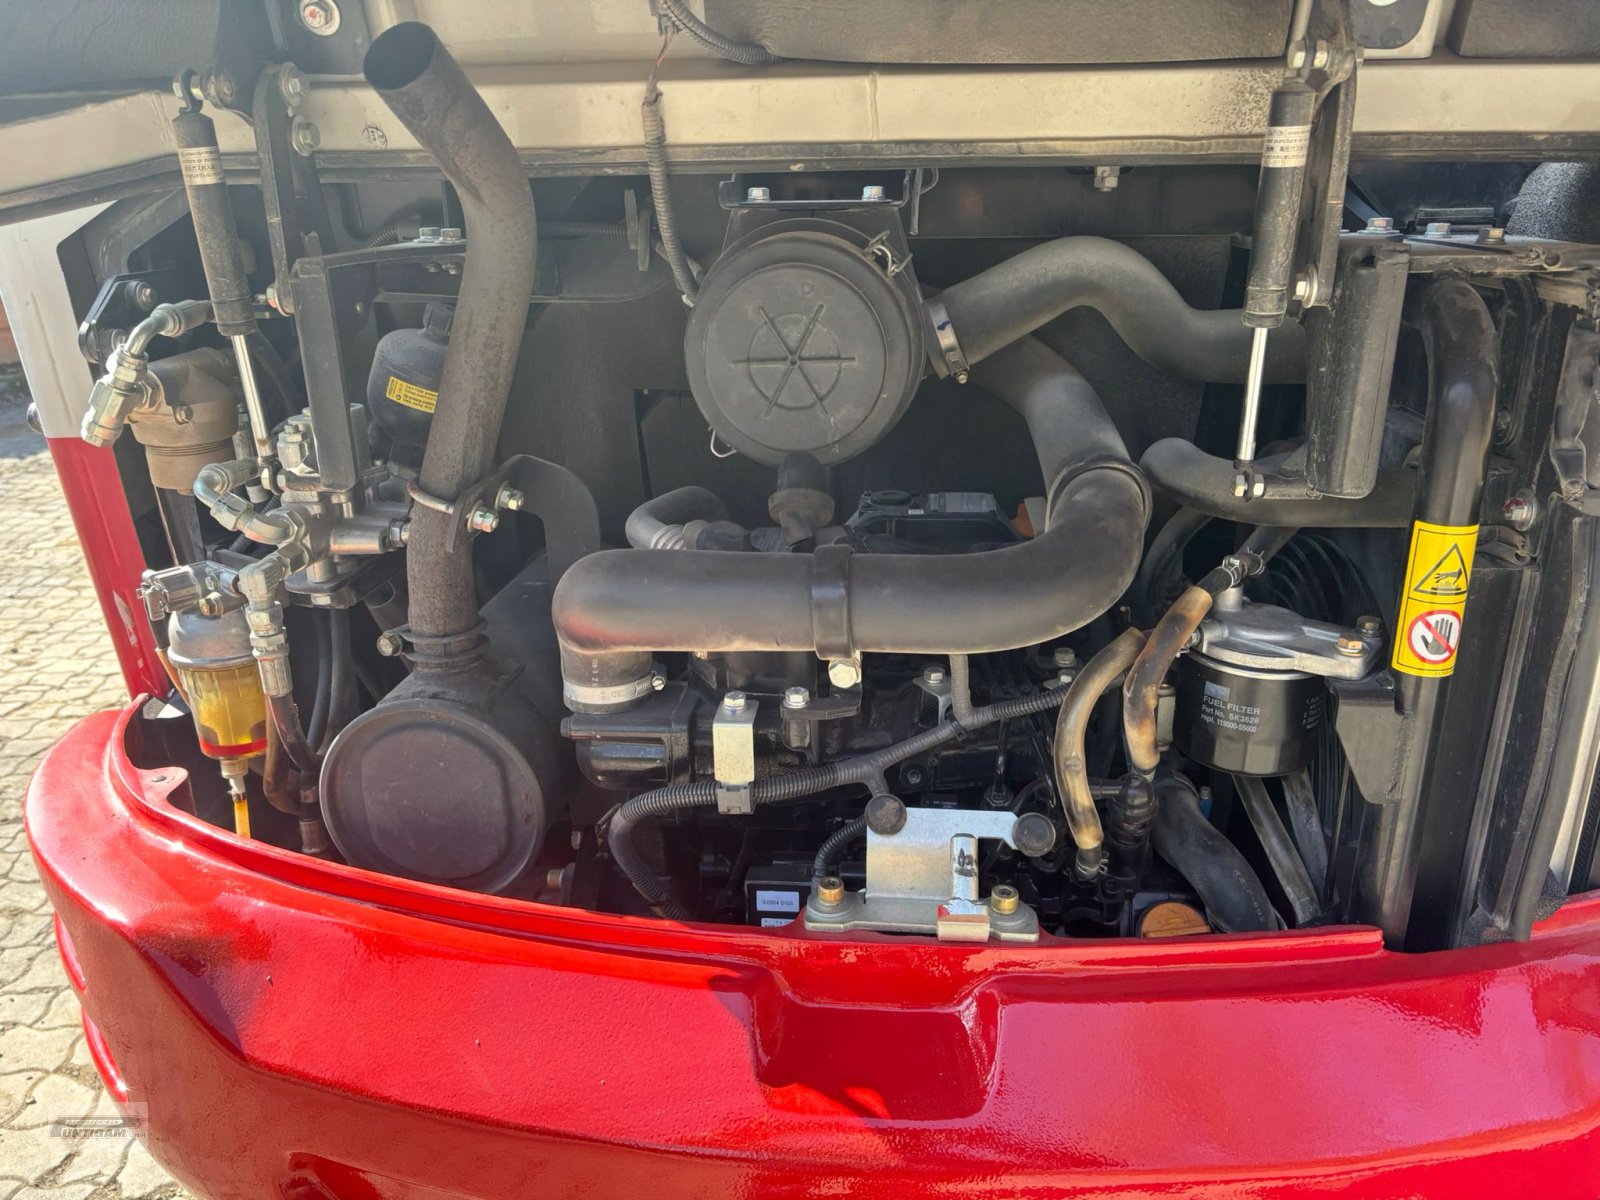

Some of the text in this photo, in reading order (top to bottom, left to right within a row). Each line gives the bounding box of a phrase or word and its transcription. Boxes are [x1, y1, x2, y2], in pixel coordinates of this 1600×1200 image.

[1201, 704, 1214, 714] Part
[1214, 708, 1226, 719] No.
[1203, 695, 1261, 716] FUEL FILTER
